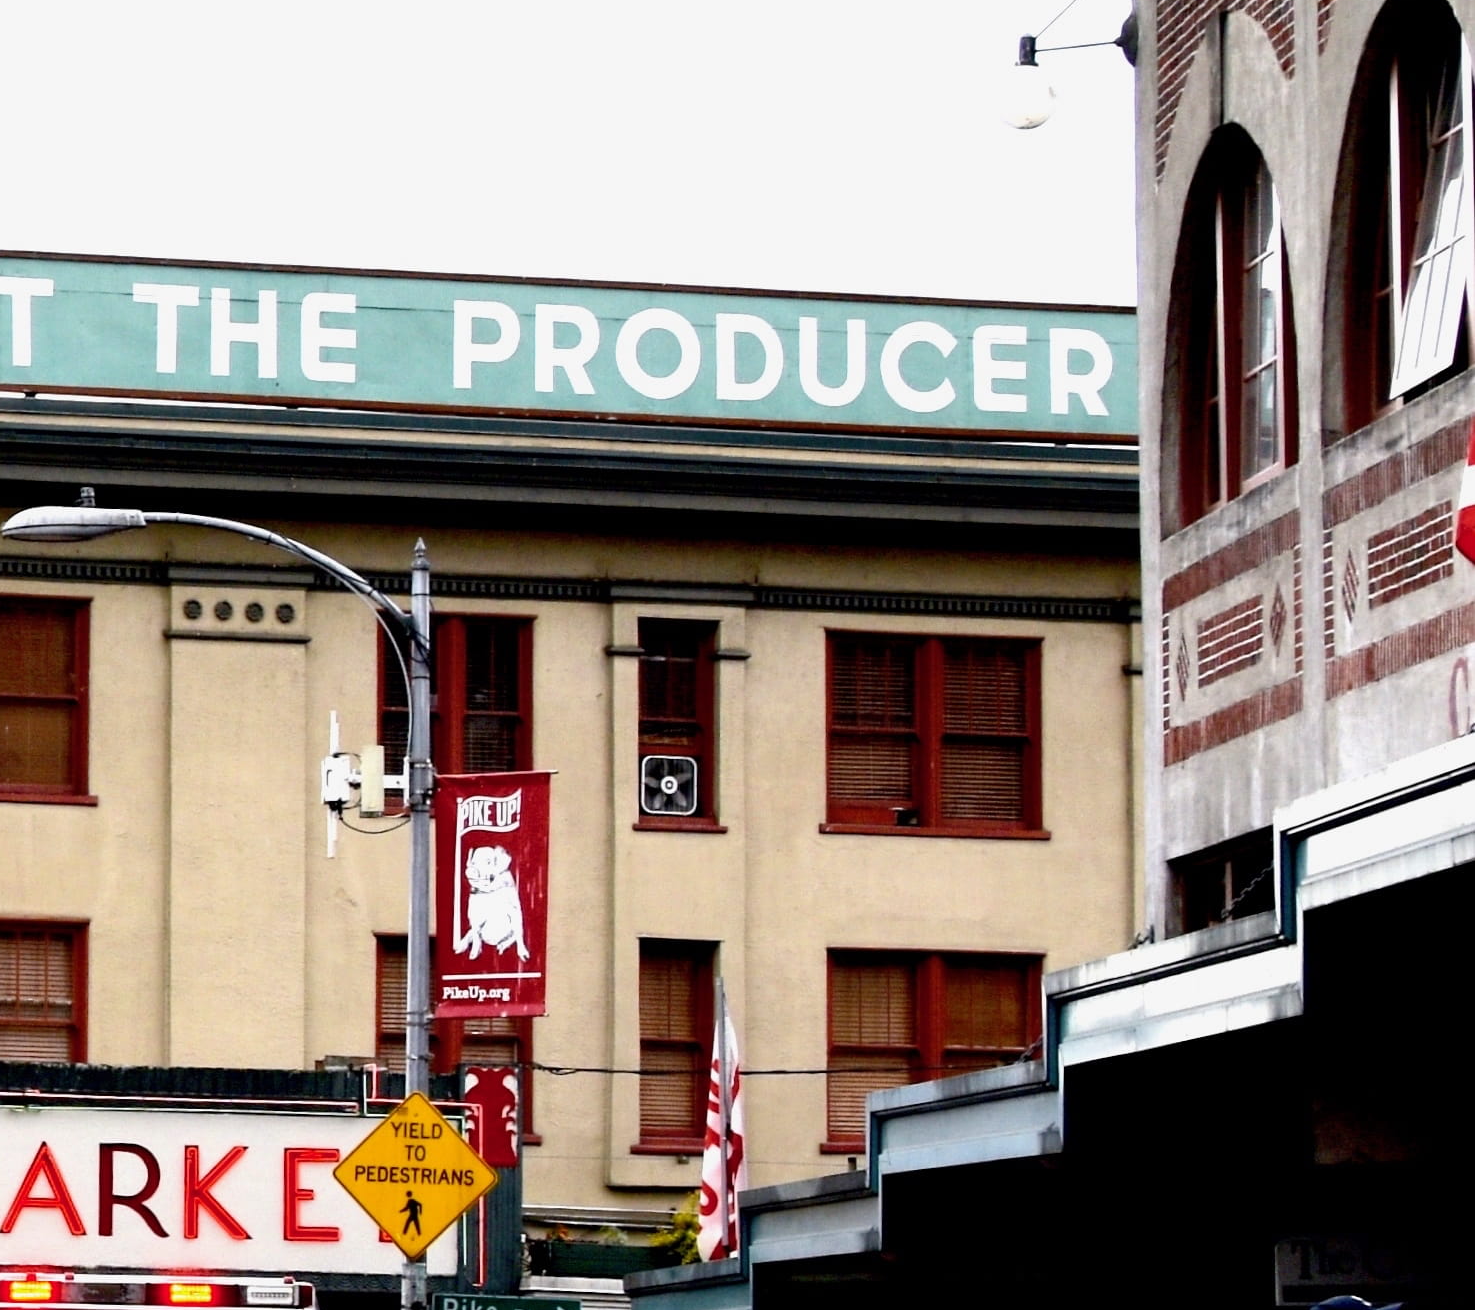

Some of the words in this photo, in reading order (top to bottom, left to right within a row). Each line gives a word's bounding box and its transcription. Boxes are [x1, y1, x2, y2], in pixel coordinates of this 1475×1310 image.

[132, 282, 358, 384] THE
[452, 298, 1114, 417] PRODUCER
[460, 799, 494, 829] PIKE
[495, 794, 521, 827] UP!
[442, 986, 511, 1002] PikeUp.org
[391, 1121, 443, 1140] YIELD
[404, 1144, 426, 1162] TO
[354, 1165, 475, 1186] PEDESTRIANS
